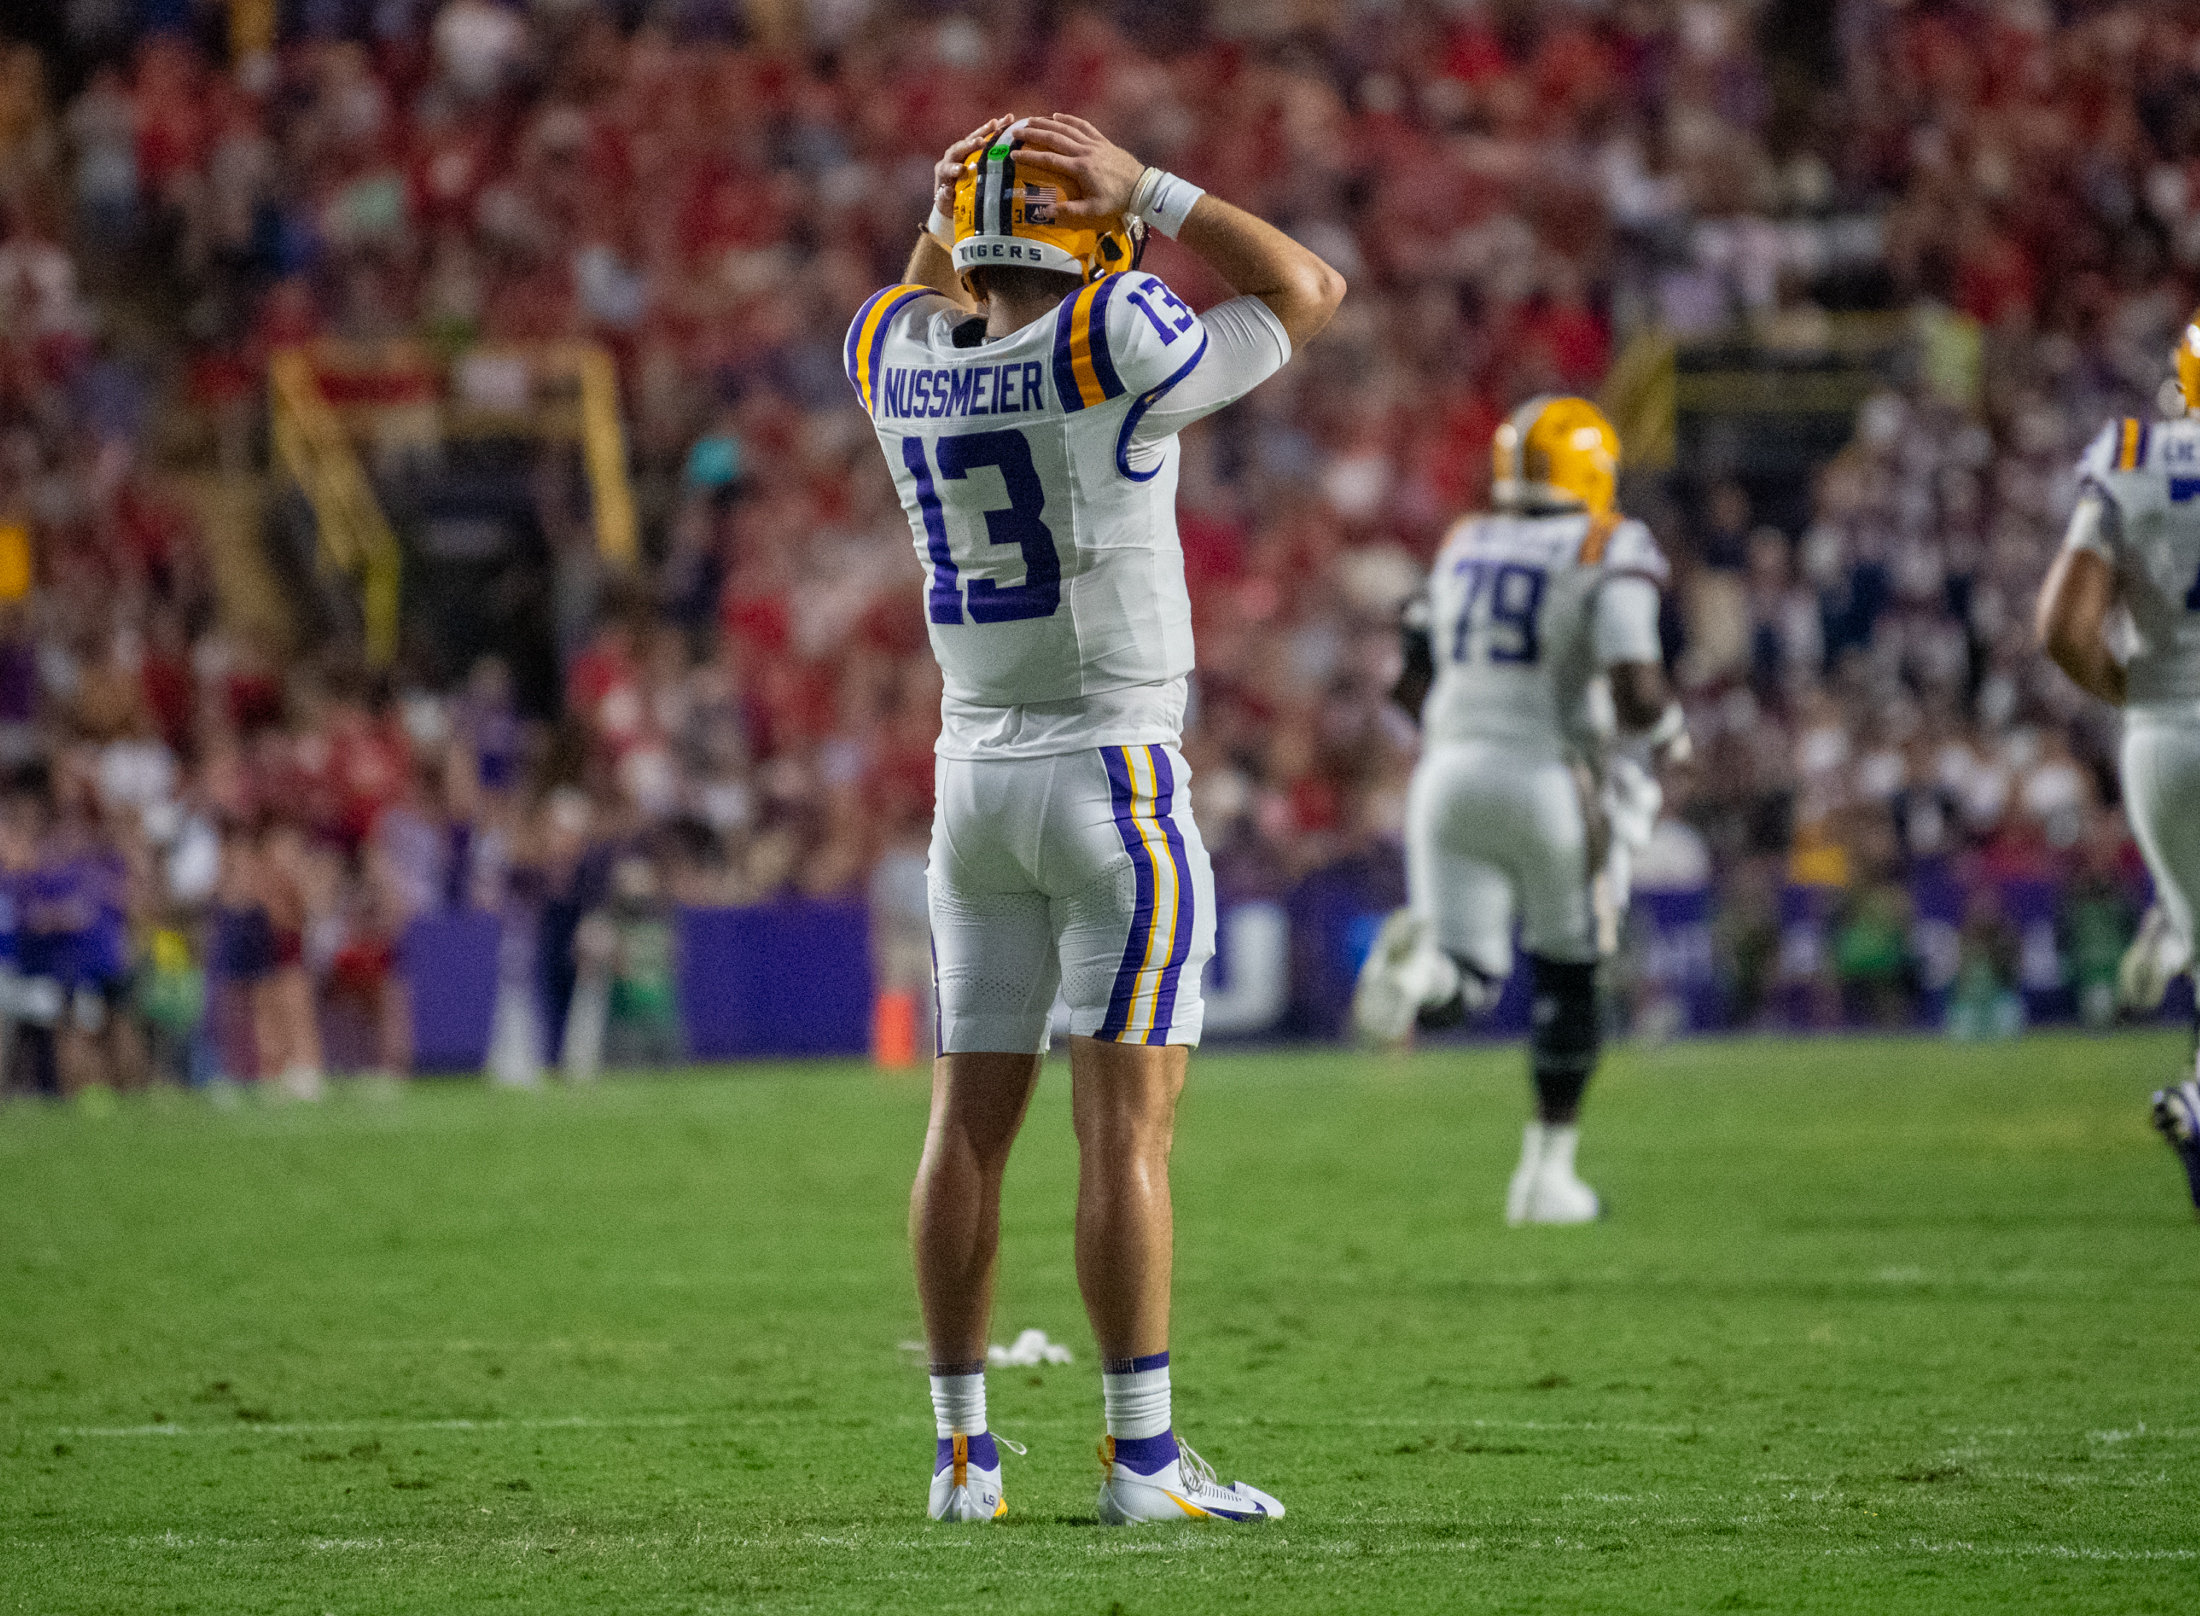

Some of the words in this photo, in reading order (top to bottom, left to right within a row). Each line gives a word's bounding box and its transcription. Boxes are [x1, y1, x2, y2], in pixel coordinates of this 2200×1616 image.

[959, 244, 1041, 261] TIGERS
[1126, 277, 1194, 346] 13
[884, 360, 1044, 418] NUSSMEIER
[902, 429, 1061, 625] 13
[1454, 558, 1547, 666] 79
